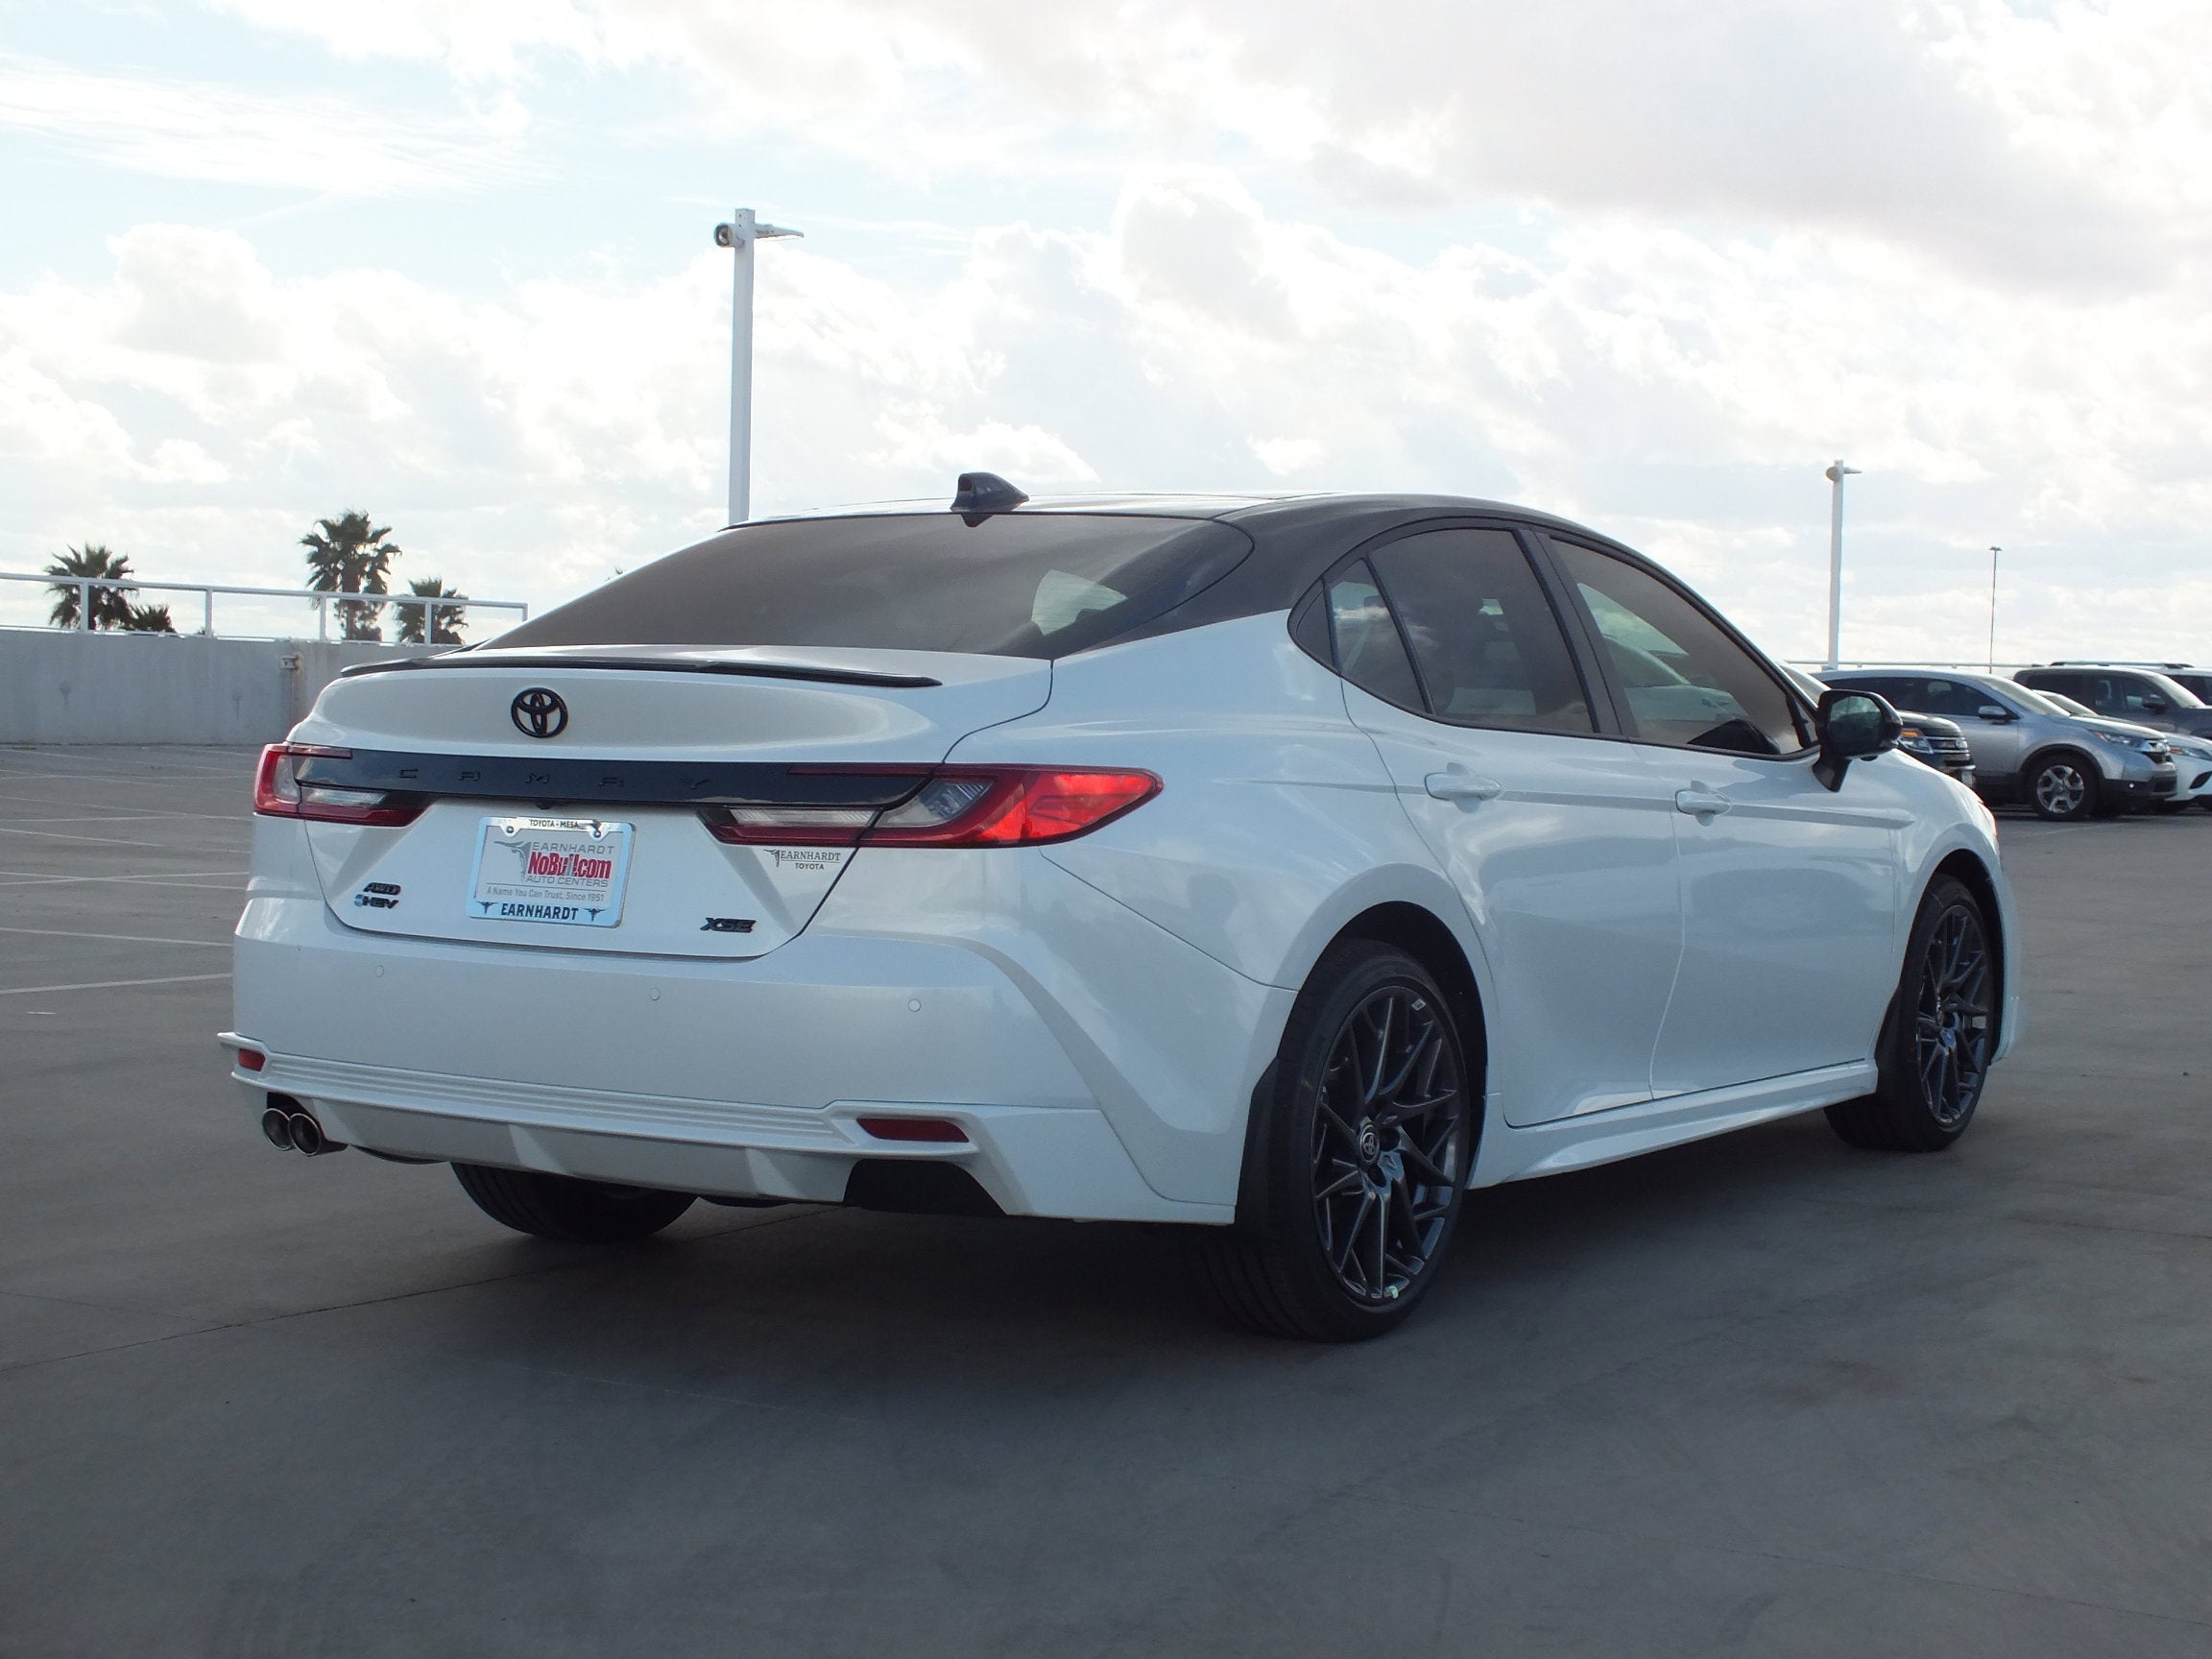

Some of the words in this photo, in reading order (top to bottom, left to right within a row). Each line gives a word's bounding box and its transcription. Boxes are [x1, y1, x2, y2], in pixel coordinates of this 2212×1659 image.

[398, 767, 710, 790] CAMRY
[529, 819, 555, 828] TOYOTA
[532, 841, 614, 854] EARNHARDT
[781, 851, 841, 861] EARNHARDT
[527, 876, 554, 884] AUTO
[557, 878, 609, 888] CENTERS
[493, 888, 513, 897] Name
[515, 888, 527, 897] You
[529, 889, 542, 898] Can
[565, 891, 587, 901] Since
[589, 893, 605, 902] 1951
[501, 902, 580, 921] EARNHARDT
[700, 917, 757, 933] XSE
